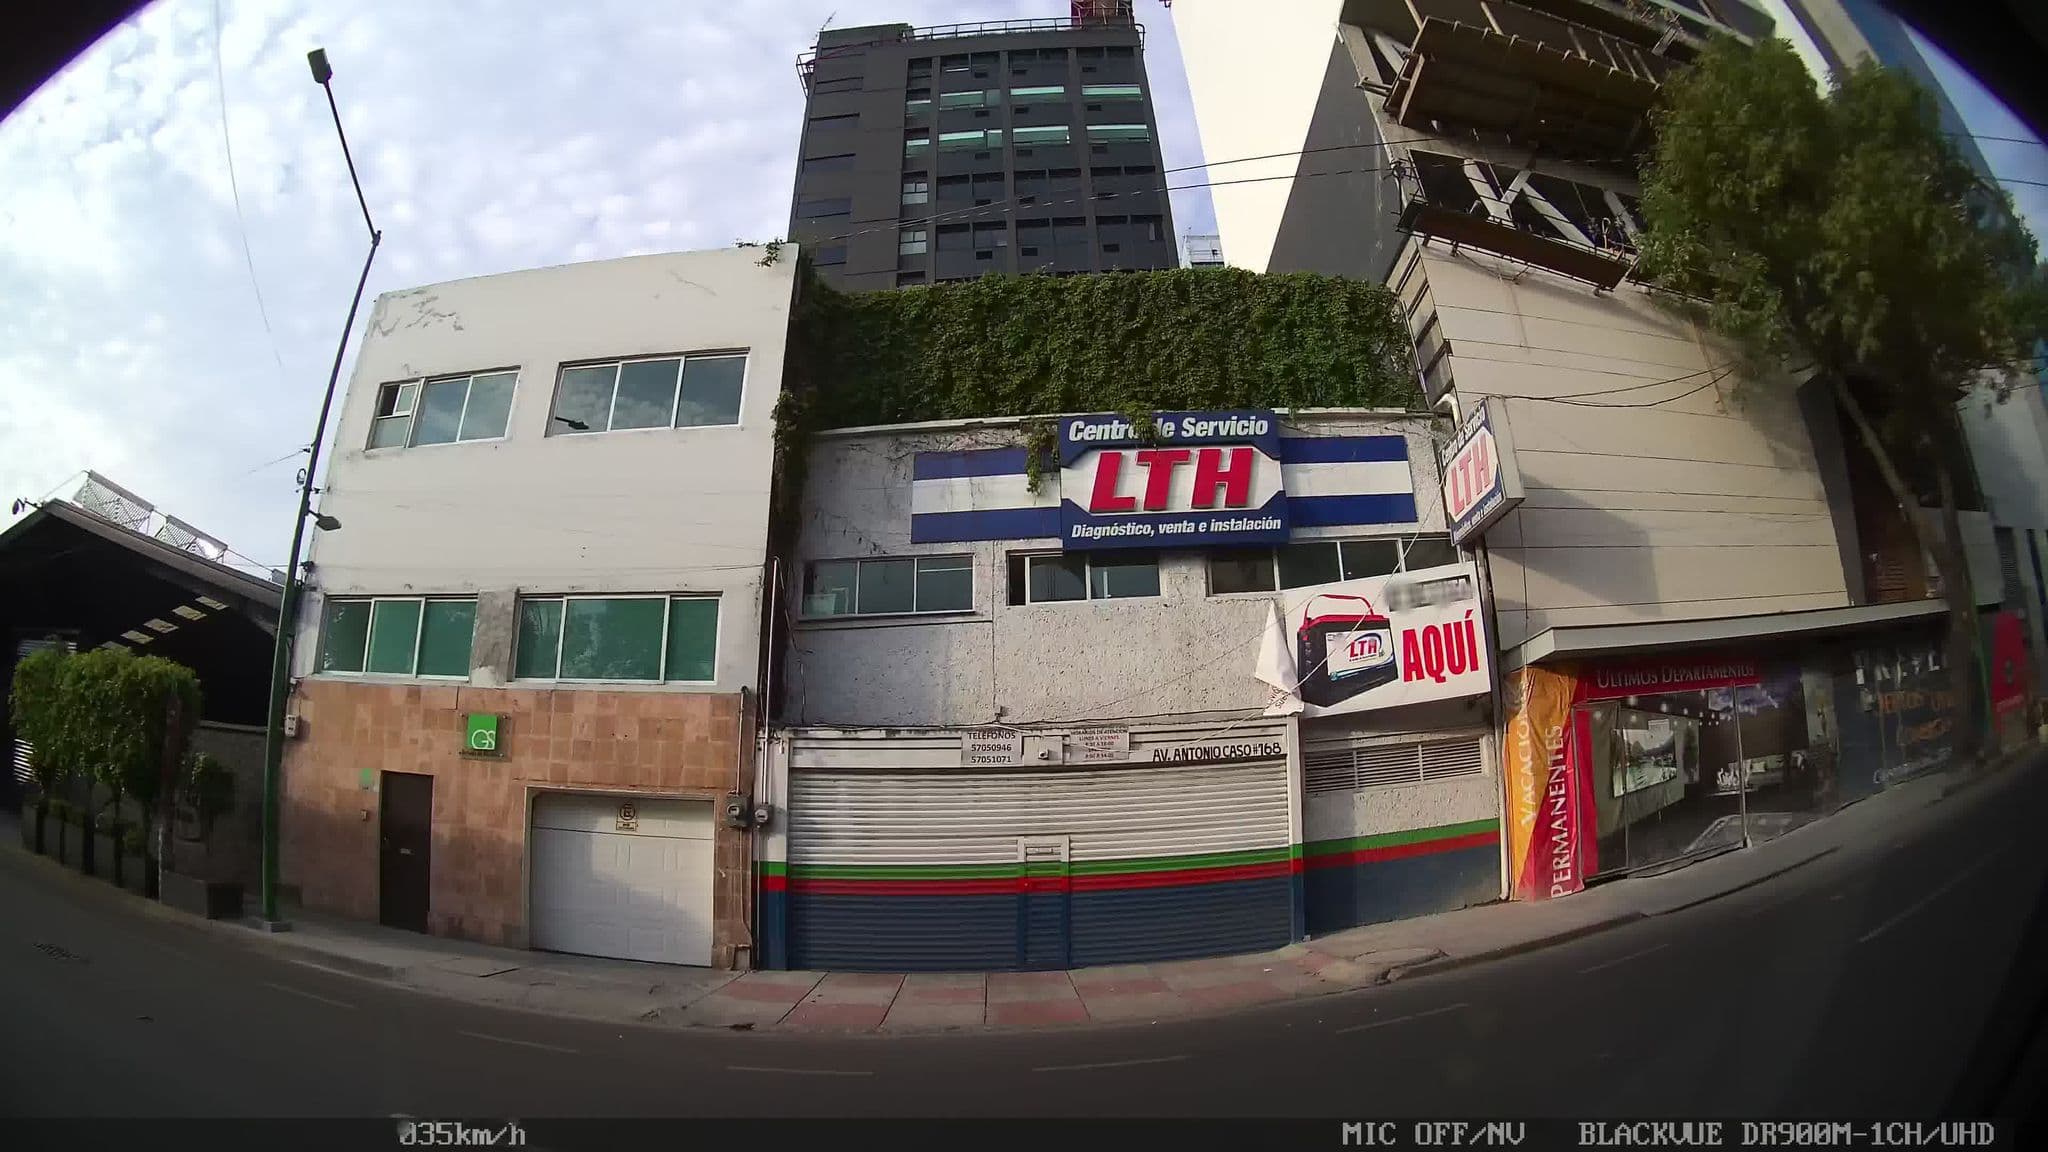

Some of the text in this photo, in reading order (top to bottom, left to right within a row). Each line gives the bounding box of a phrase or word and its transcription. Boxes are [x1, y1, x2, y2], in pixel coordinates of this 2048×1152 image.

[1069, 420, 1139, 442] Centro
[1181, 415, 1268, 438] Servicio
[1088, 447, 1254, 513] LTH
[1450, 433, 1491, 518] LTH
[1071, 516, 1282, 541] Diagnóstico, venta e instalación
[1350, 639, 1378, 658] LTH
[1402, 609, 1479, 683] AQUÍ
[971, 744, 1012, 752] 57050946
[971, 755, 1012, 763] 57051071
[1153, 742, 1282, 761] AV. ANTONIO CASO #168
[1545, 724, 1572, 899] PERMANENTES
